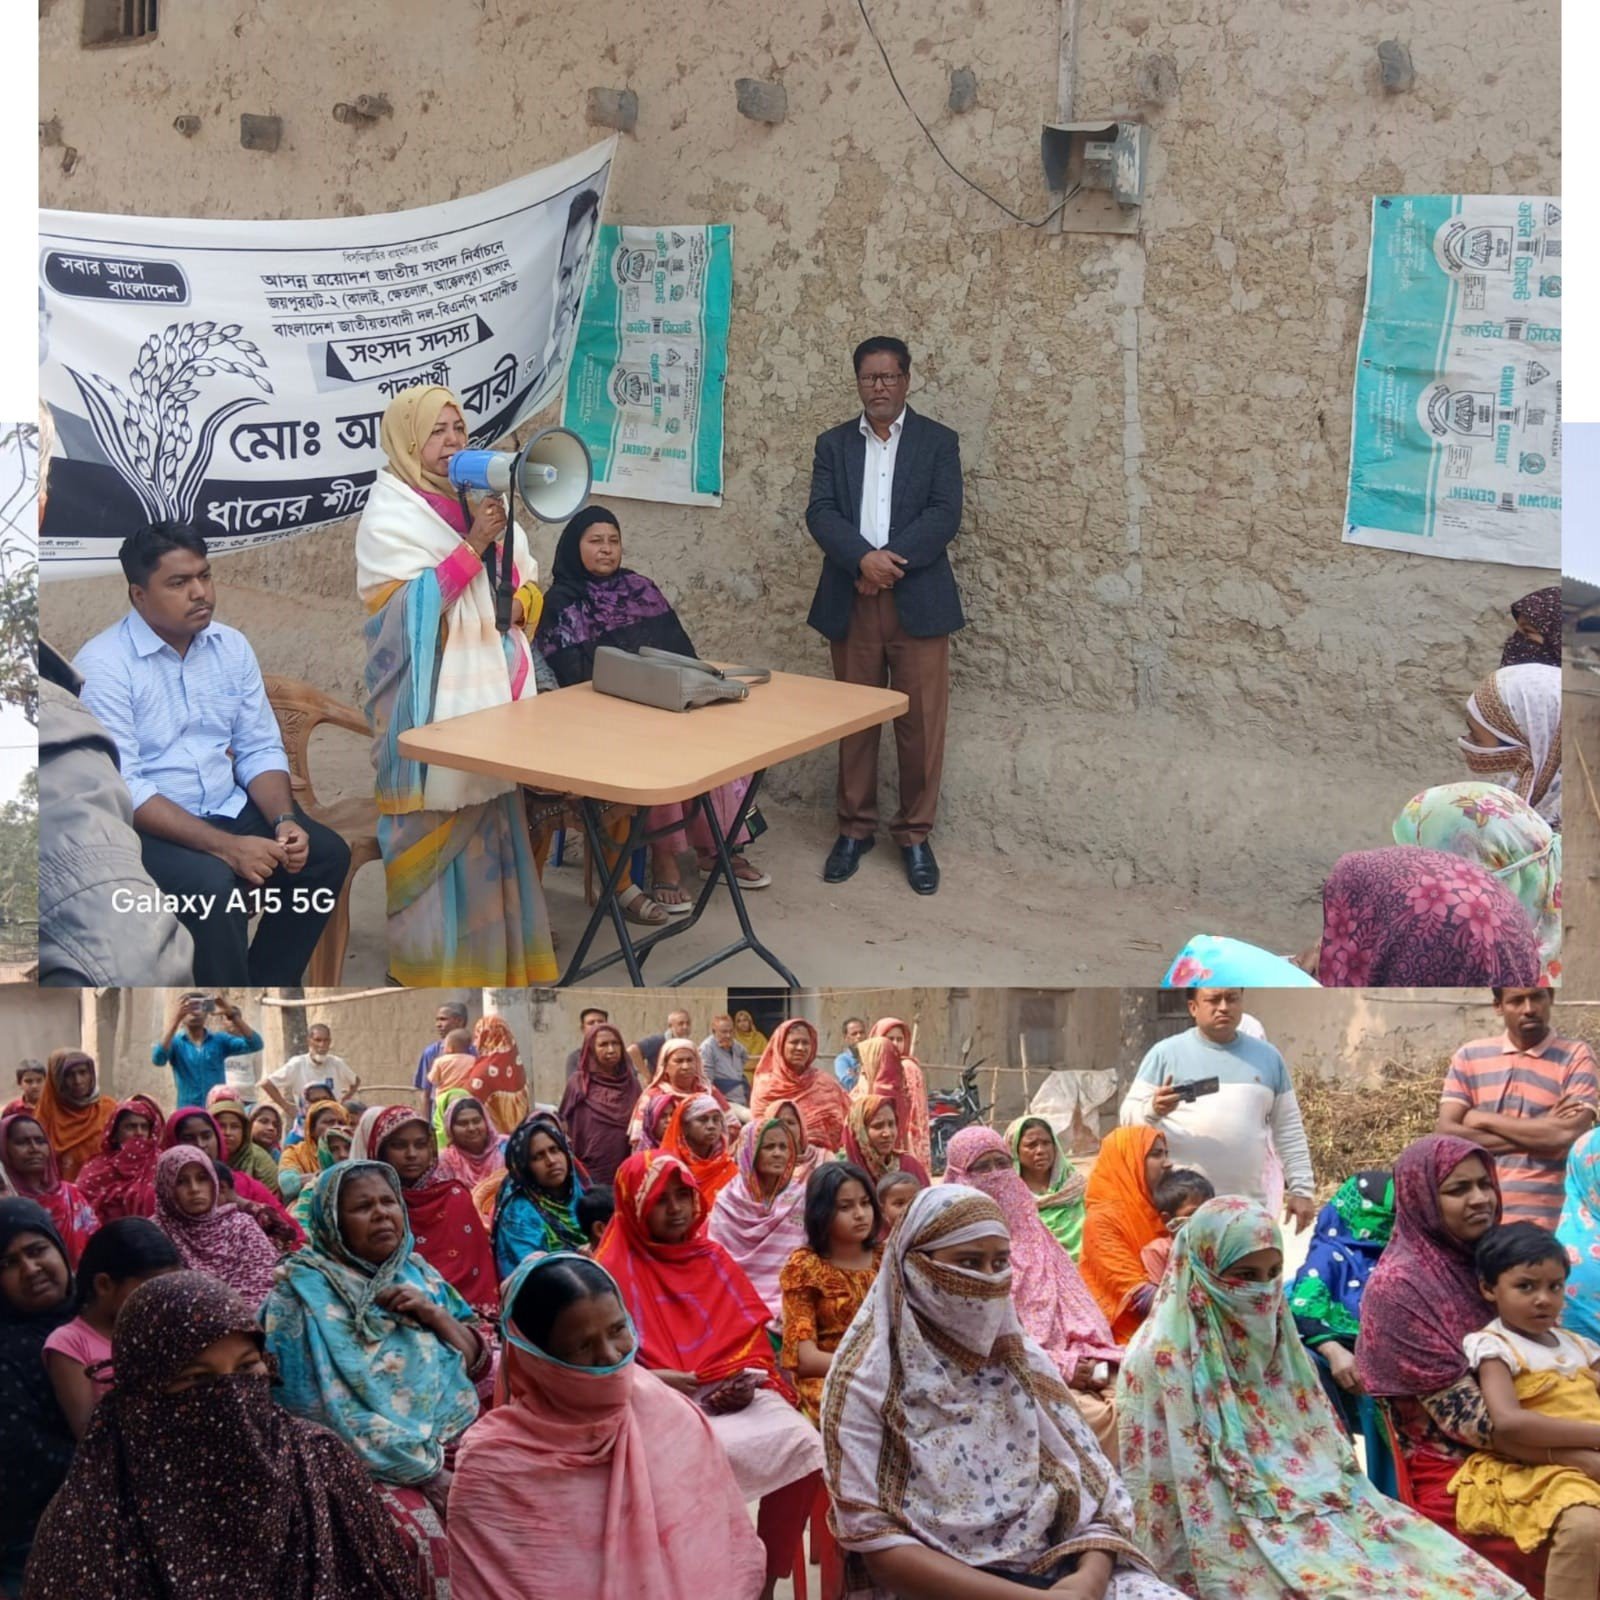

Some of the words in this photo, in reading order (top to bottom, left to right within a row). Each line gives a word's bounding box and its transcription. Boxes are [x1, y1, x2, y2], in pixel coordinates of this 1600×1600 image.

[58, 256, 101, 276] সবার
[103, 262, 145, 280] আগে
[260, 272, 308, 289] আসন্ন
[311, 270, 371, 287] ত্রয়োদশ
[374, 262, 419, 281] জাতীয়
[421, 254, 458, 273] সংসদ
[461, 240, 505, 264] নির্বাচনে
[482, 259, 513, 277] আসনে
[106, 280, 180, 300] বাংলাদেশ
[272, 320, 335, 338] বাংলাদেশ
[336, 309, 414, 332] জাতীয়তাবাদী
[479, 280, 519, 304] মনোনীত
[346, 338, 411, 364] সংসদ
[416, 322, 470, 352] সদস্য
[460, 353, 519, 415] বারী
[1498, 365, 1516, 407] CROWN
[1383, 397, 1395, 435] Cement
[229, 420, 321, 463] মোঃ
[1494, 424, 1511, 464] CEMENT
[207, 496, 314, 533] ধানের
[1446, 487, 1497, 504] CEMENT
